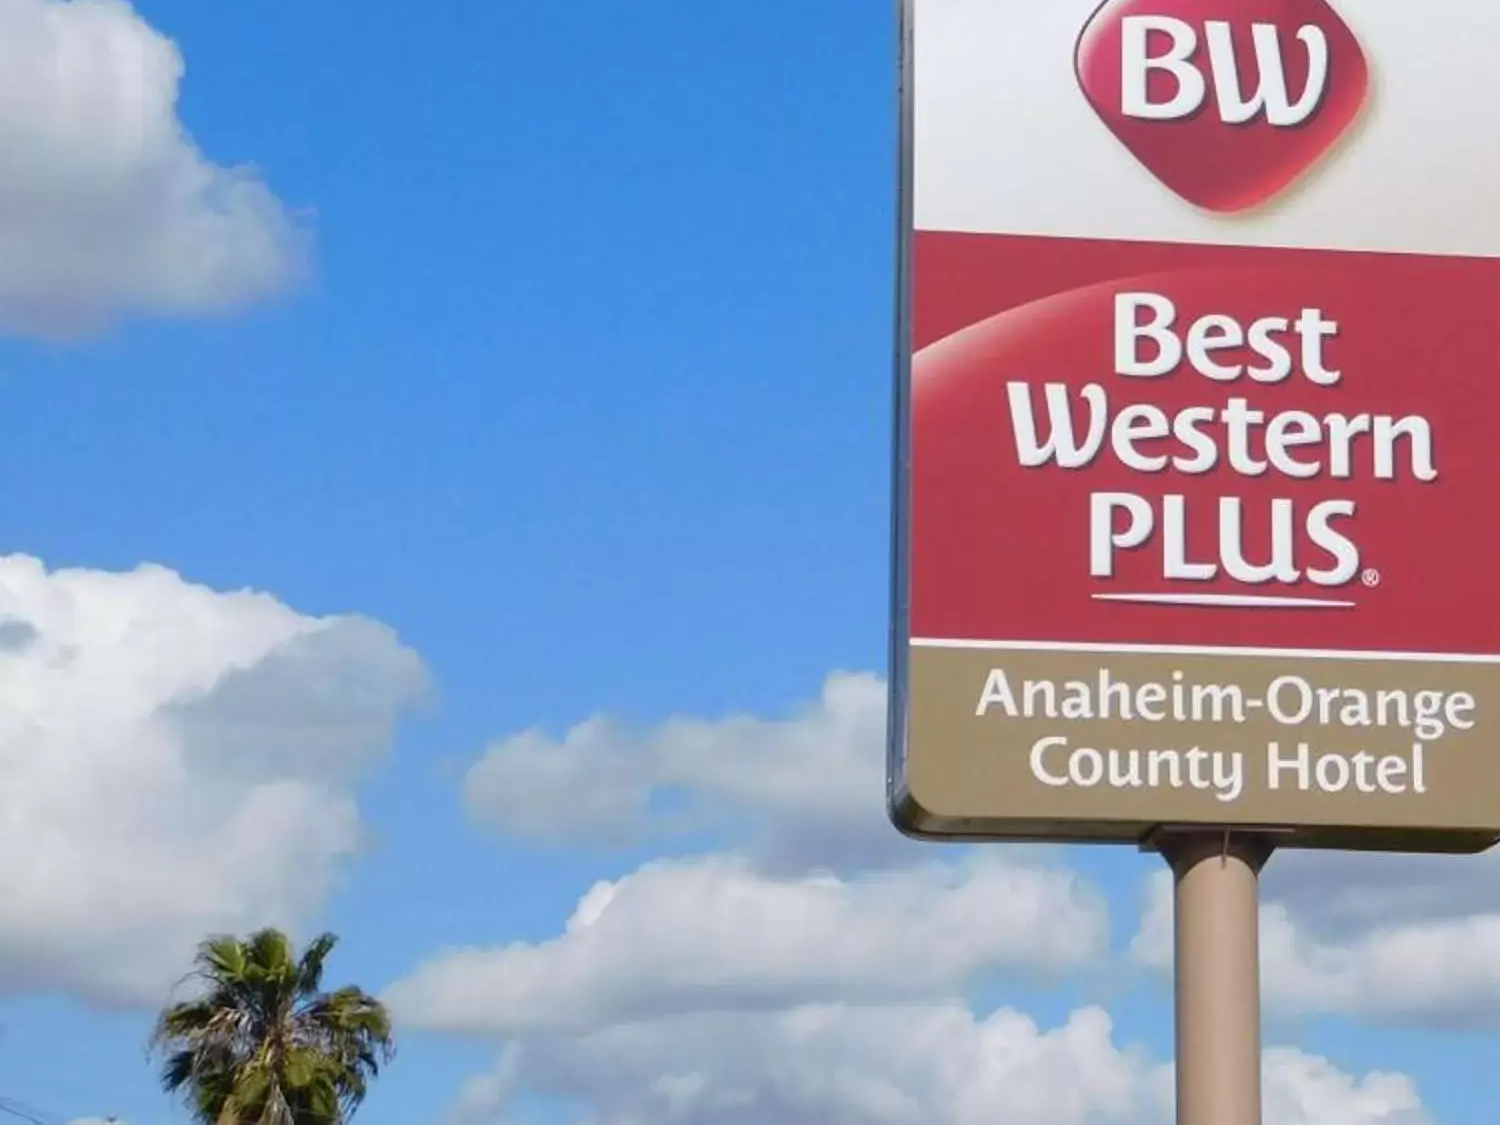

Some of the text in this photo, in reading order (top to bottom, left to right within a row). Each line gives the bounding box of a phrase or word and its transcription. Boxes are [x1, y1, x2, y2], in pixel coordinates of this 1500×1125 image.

[1120, 15, 1328, 126] BW
[1113, 291, 1341, 385] Best
[1006, 381, 1438, 481] Western
[975, 668, 1475, 740] Anaheim-Orange
[1029, 736, 1426, 802] County Hotel
